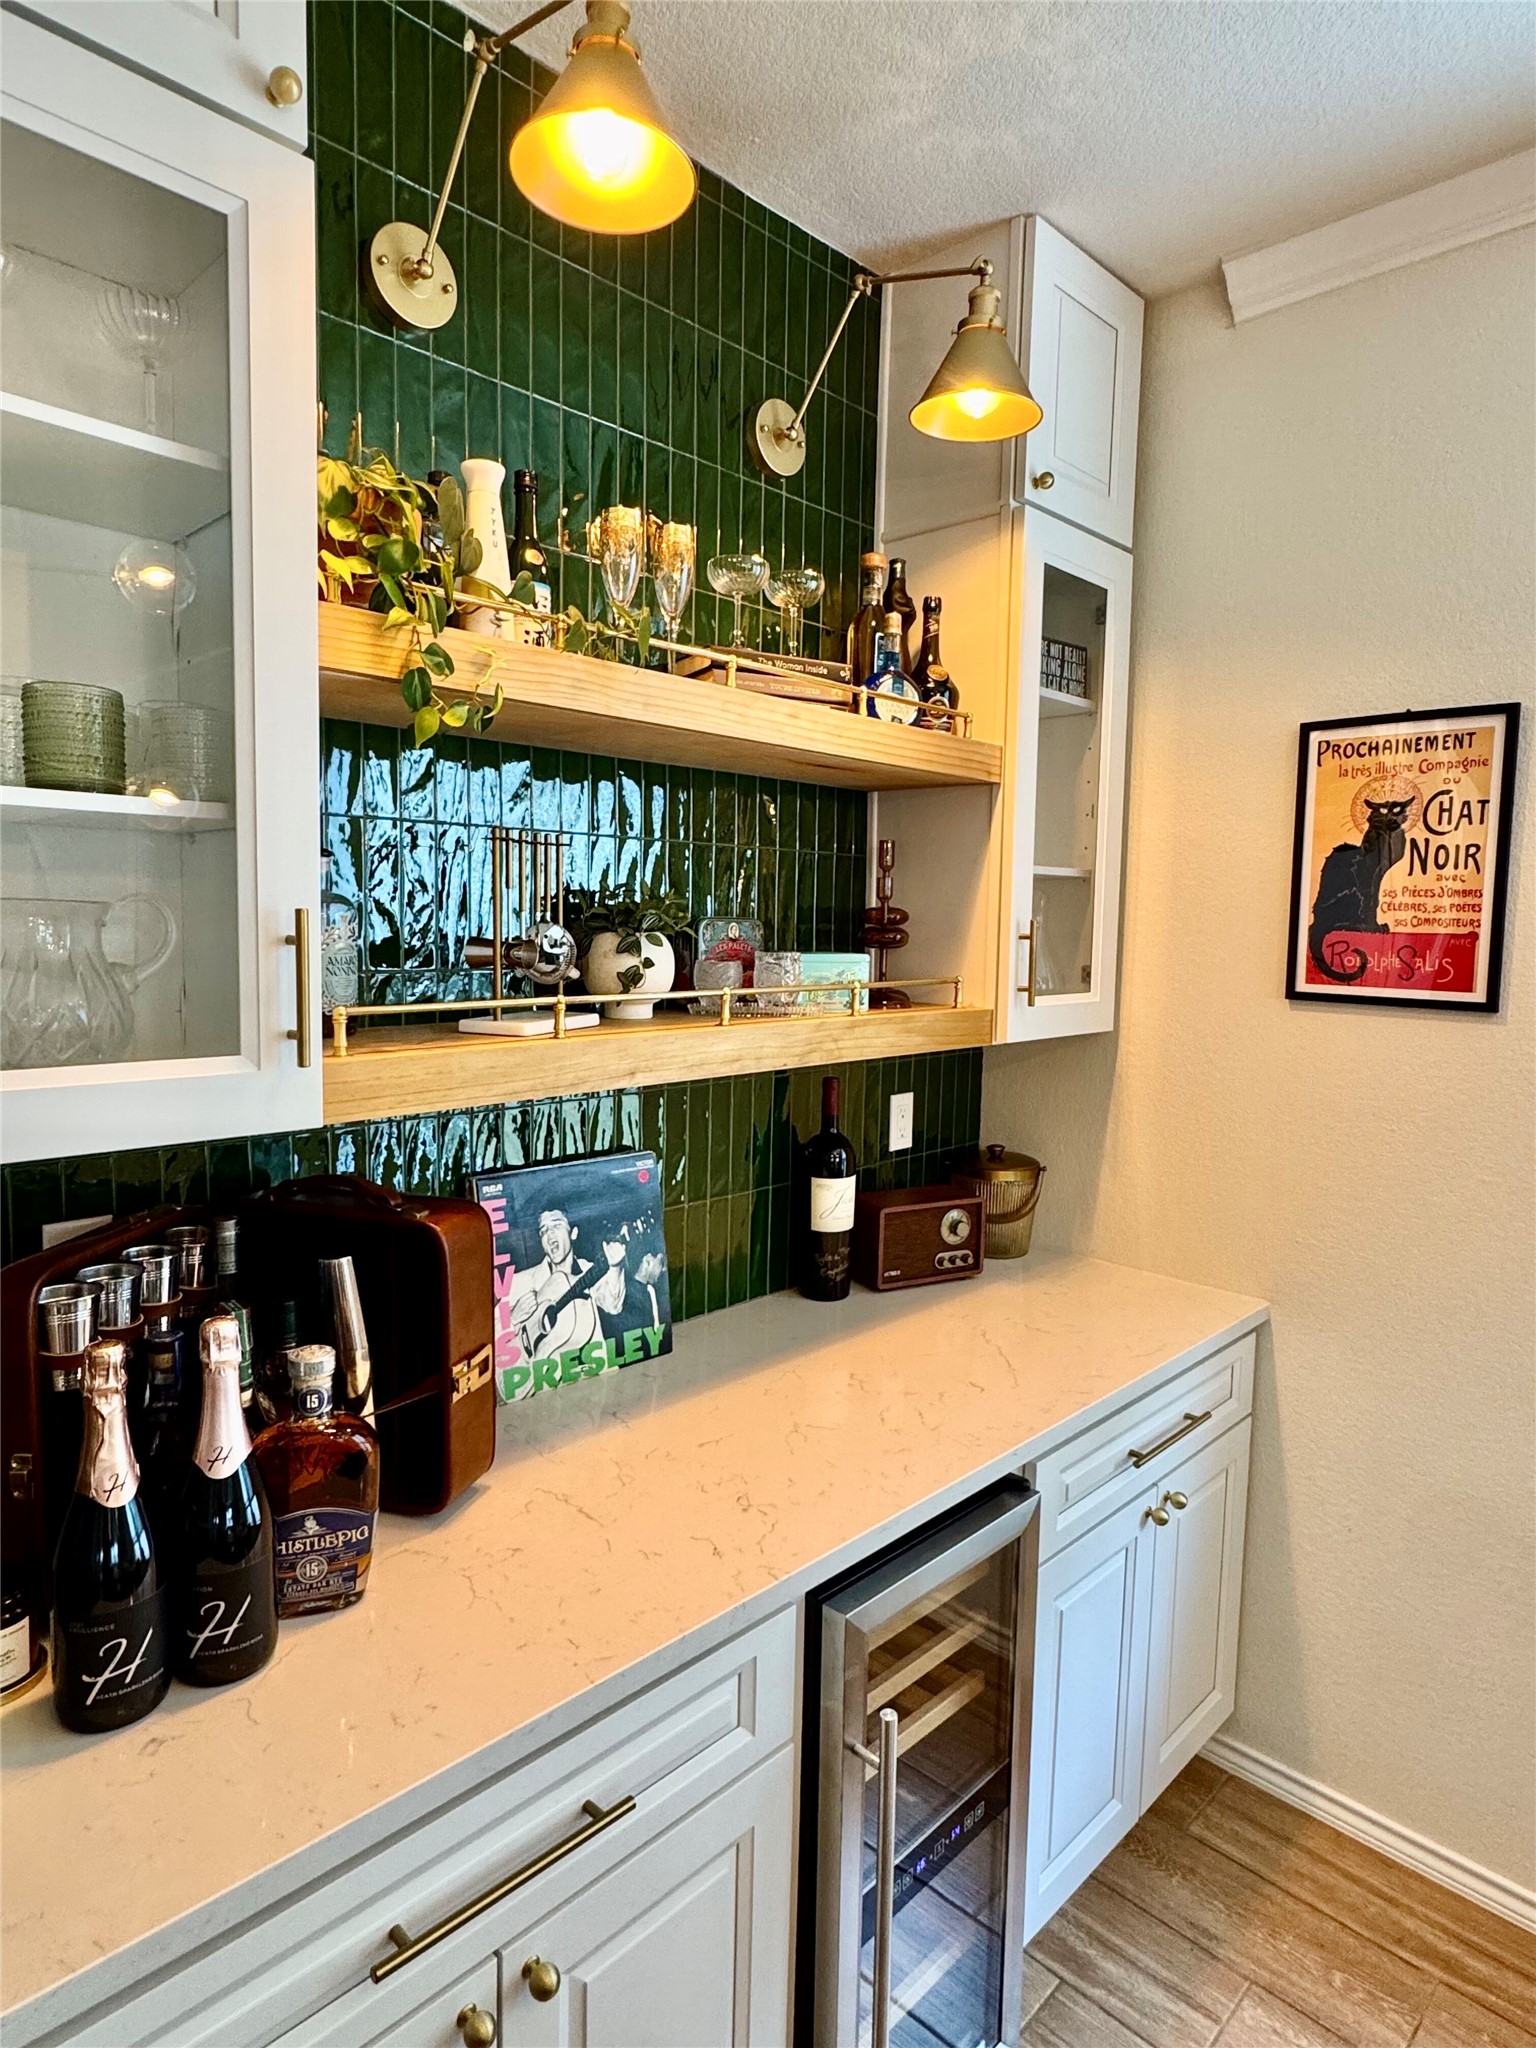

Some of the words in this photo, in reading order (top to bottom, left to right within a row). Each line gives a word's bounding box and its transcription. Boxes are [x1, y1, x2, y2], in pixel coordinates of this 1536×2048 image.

[1050, 642, 1062, 660] NOT
[757, 656, 773, 667] The
[775, 659, 803, 672] Woman
[805, 664, 828, 675] Inside
[1063, 660, 1086, 683] ALONE
[1047, 675, 1060, 692] CAT
[1061, 677, 1068, 694] IS
[1317, 732, 1477, 767] PROCHAINEMENT
[1339, 763, 1349, 778] la
[1375, 761, 1414, 778] illustre
[1419, 754, 1490, 775] Compagnie
[1422, 788, 1491, 836] CHAT
[1408, 837, 1481, 877] NOIR
[1410, 915, 1482, 930] COMPOSITEURS
[1450, 938, 1472, 948] AVEC
[482, 1183, 503, 1195] RCA
[479, 1198, 522, 1369] ELVIS
[502, 1323, 666, 1401] PRESLEY
[306, 1394, 319, 1409] 15
[277, 1525, 370, 1555] HISTLEPIG
[306, 1561, 319, 1578] 15
